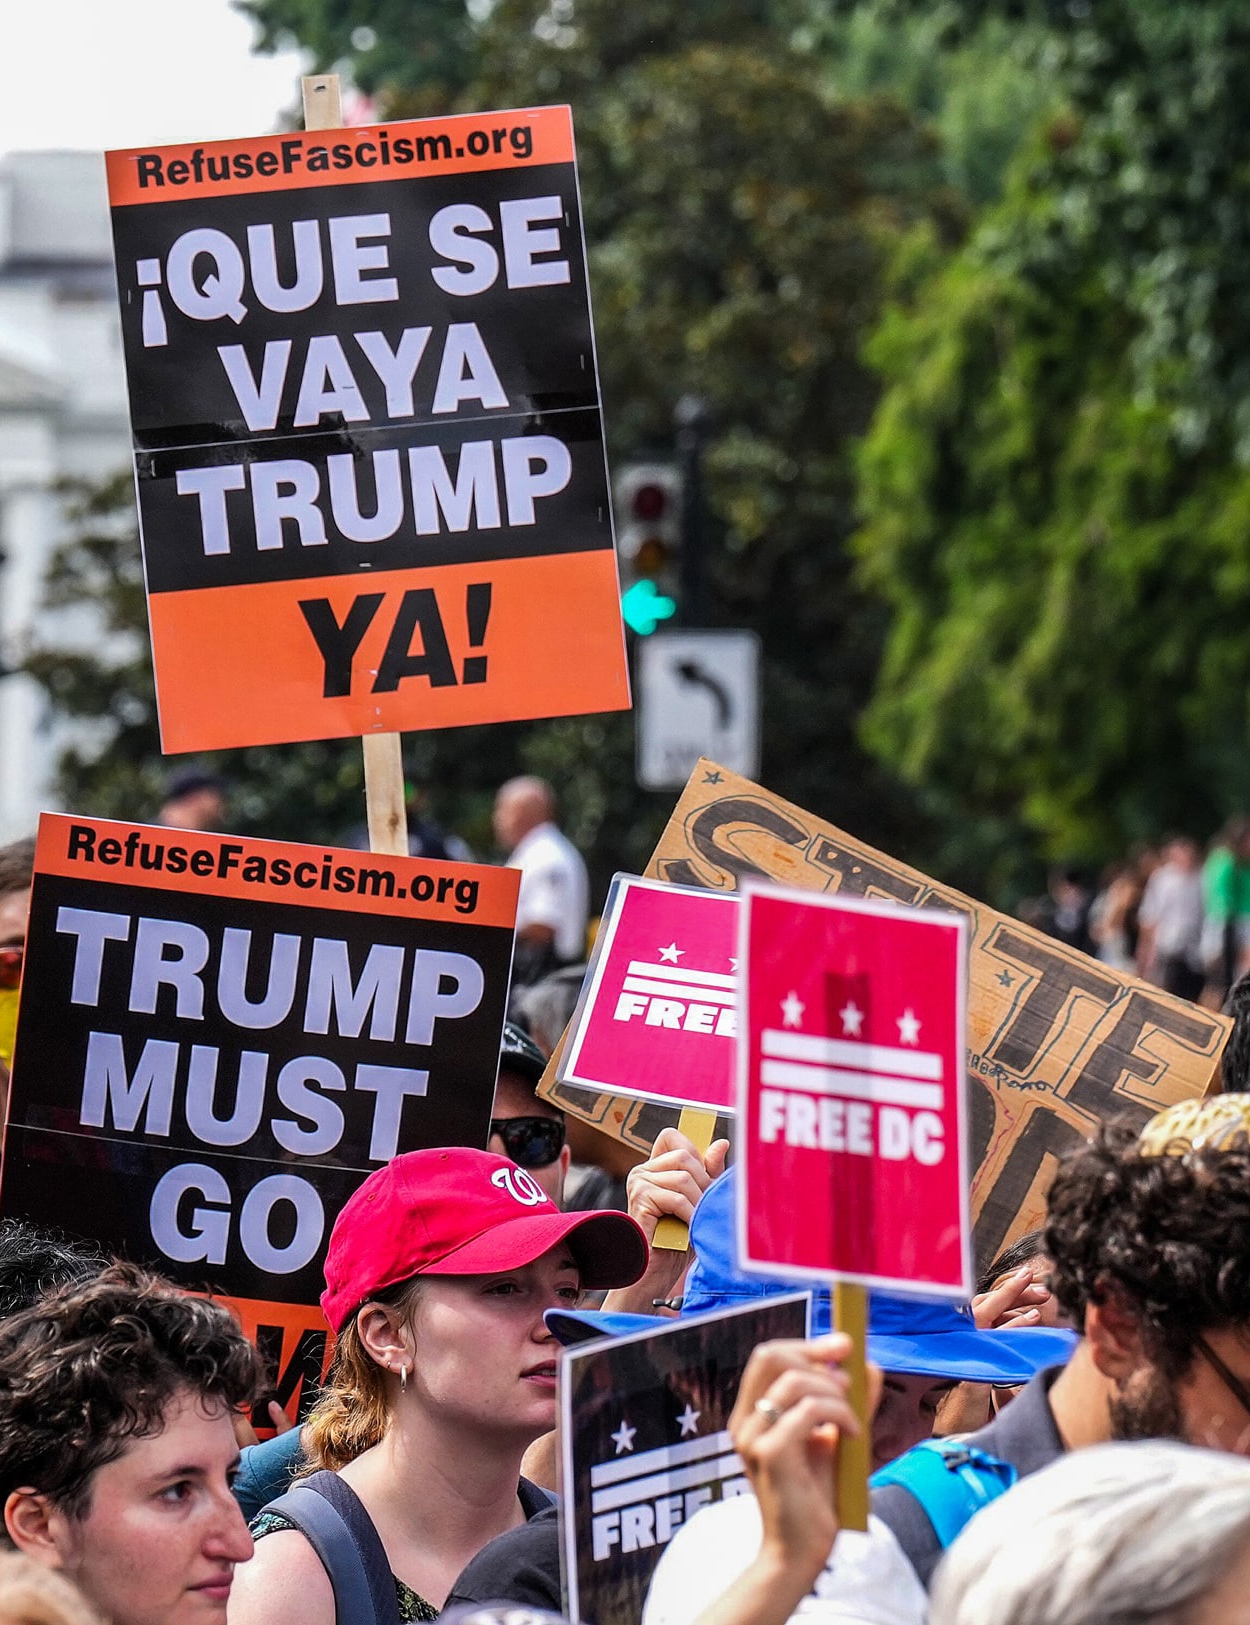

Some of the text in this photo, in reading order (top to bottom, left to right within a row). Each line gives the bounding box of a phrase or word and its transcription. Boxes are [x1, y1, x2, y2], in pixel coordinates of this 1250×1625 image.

[137, 121, 533, 188] RefuseFascism.org
[136, 195, 572, 348] ¡QUE SE
[217, 322, 510, 432] VAYA
[175, 435, 573, 556] TRUMP
[298, 582, 493, 698] YA!
[67, 825, 480, 914] RefuseFascism.org
[55, 906, 485, 1046] TRUMP
[79, 1031, 430, 1161] MUST
[759, 1088, 874, 1157] FREE
[878, 1105, 945, 1166] DC
[149, 1162, 325, 1275] GO
